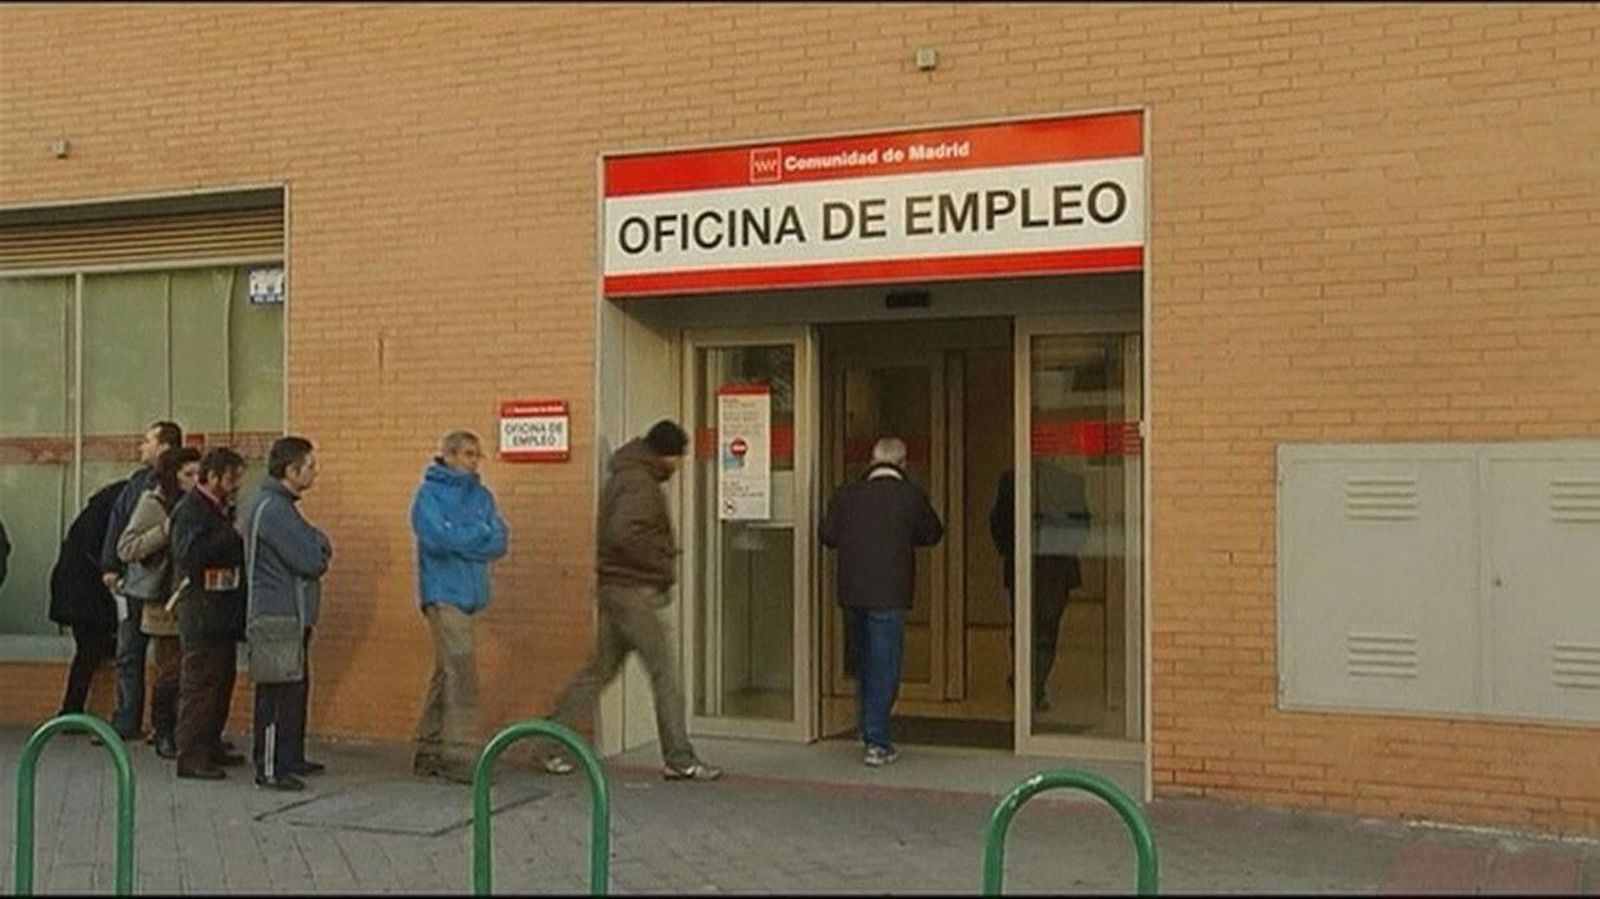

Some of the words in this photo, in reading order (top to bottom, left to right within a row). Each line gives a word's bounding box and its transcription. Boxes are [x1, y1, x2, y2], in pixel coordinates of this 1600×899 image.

[784, 149, 878, 171] Comunidad
[882, 147, 904, 163] de
[908, 142, 970, 160] Madrid
[618, 205, 807, 255] OFICINA
[822, 199, 887, 241] DE
[905, 181, 1127, 236] EMPLEO
